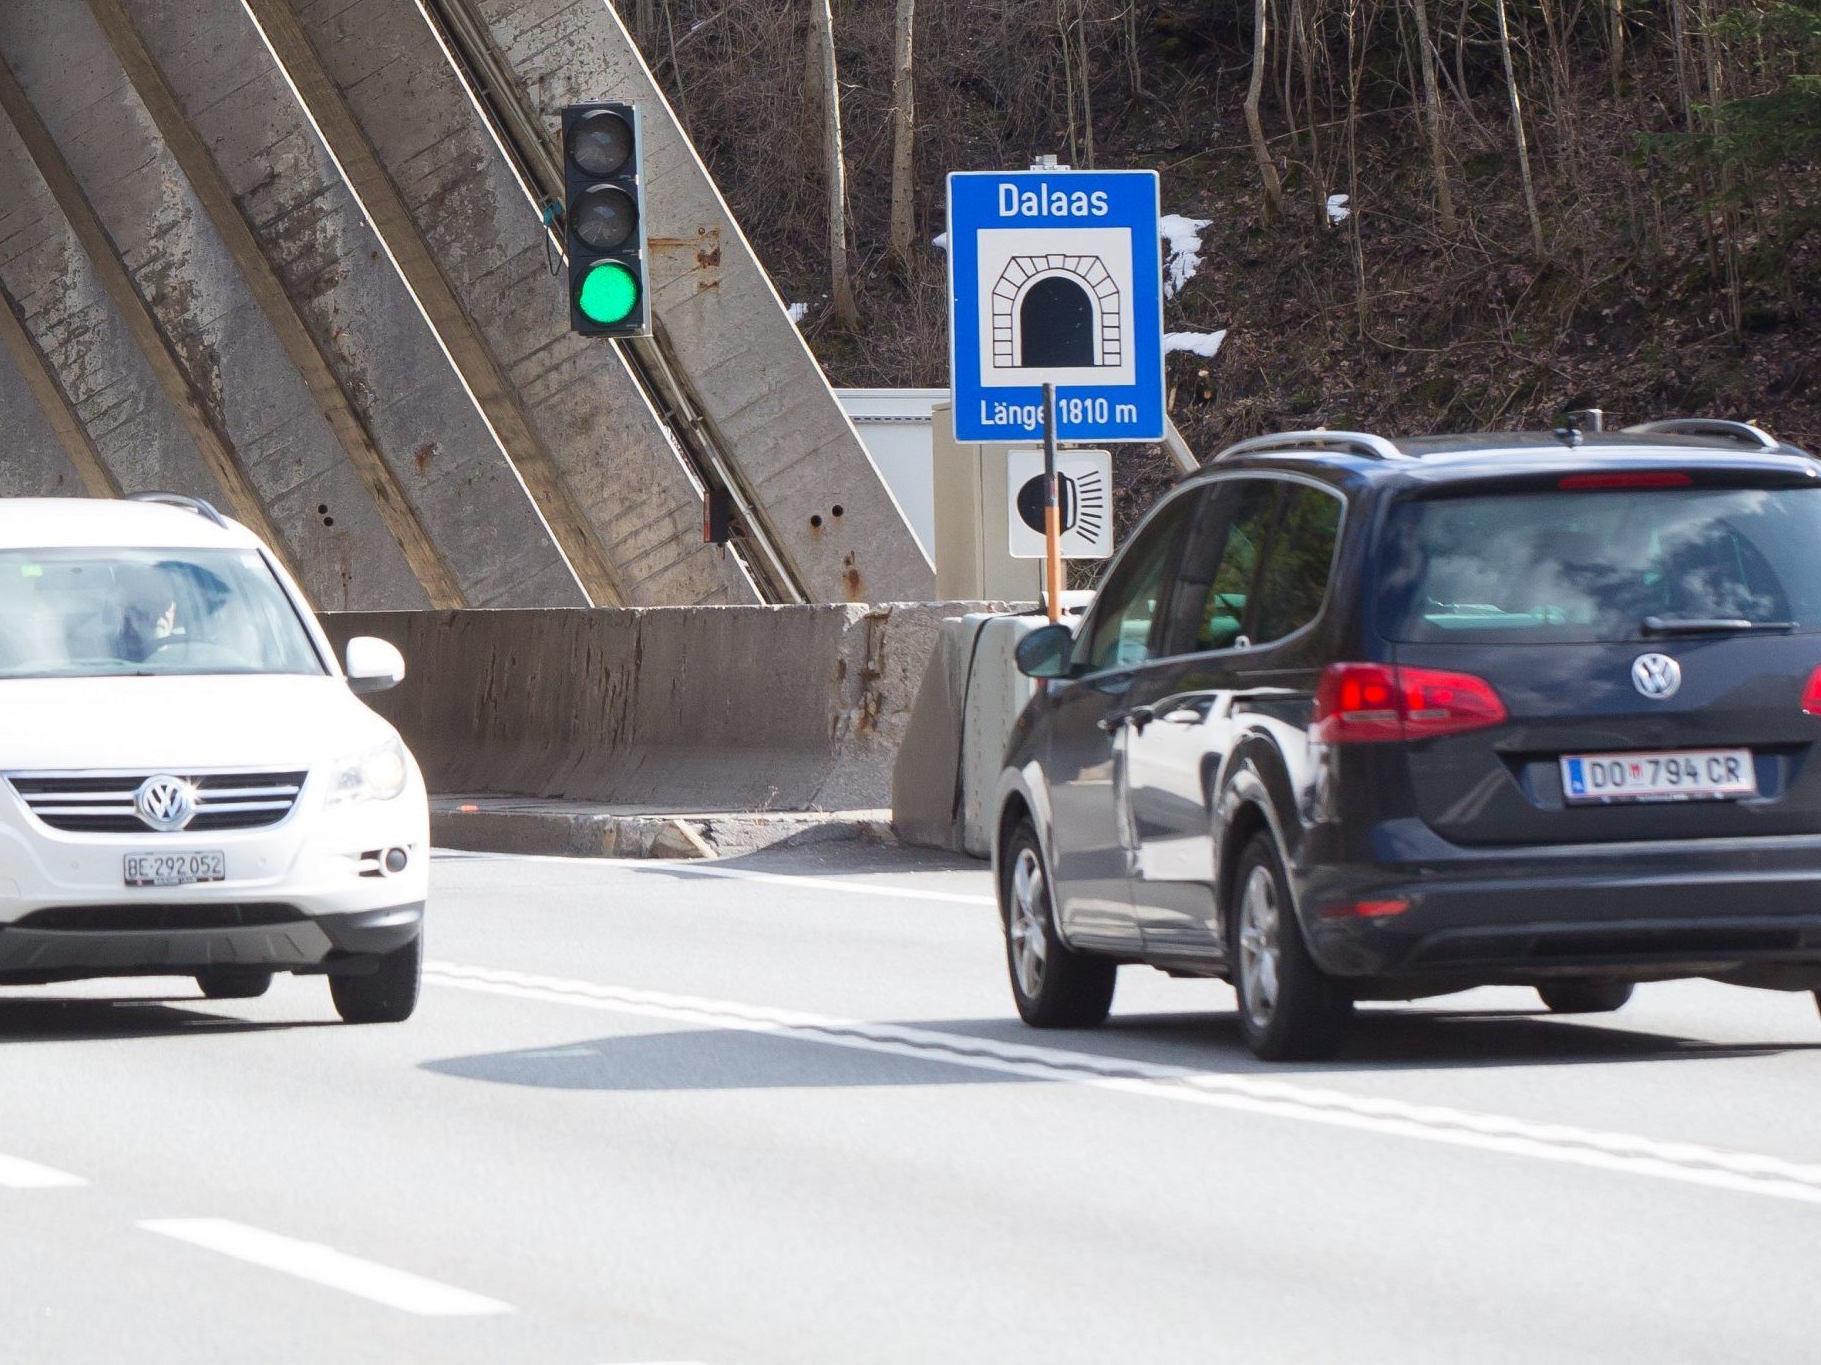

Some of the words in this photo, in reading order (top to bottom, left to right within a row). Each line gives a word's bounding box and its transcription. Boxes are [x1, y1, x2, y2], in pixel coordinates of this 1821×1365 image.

[998, 182, 1109, 217] Dalaas
[1058, 397, 1109, 424] 1810
[1115, 403, 1138, 424] m
[1590, 761, 1625, 788] DO
[1647, 758, 1699, 786] 794
[1707, 756, 1741, 784] CR
